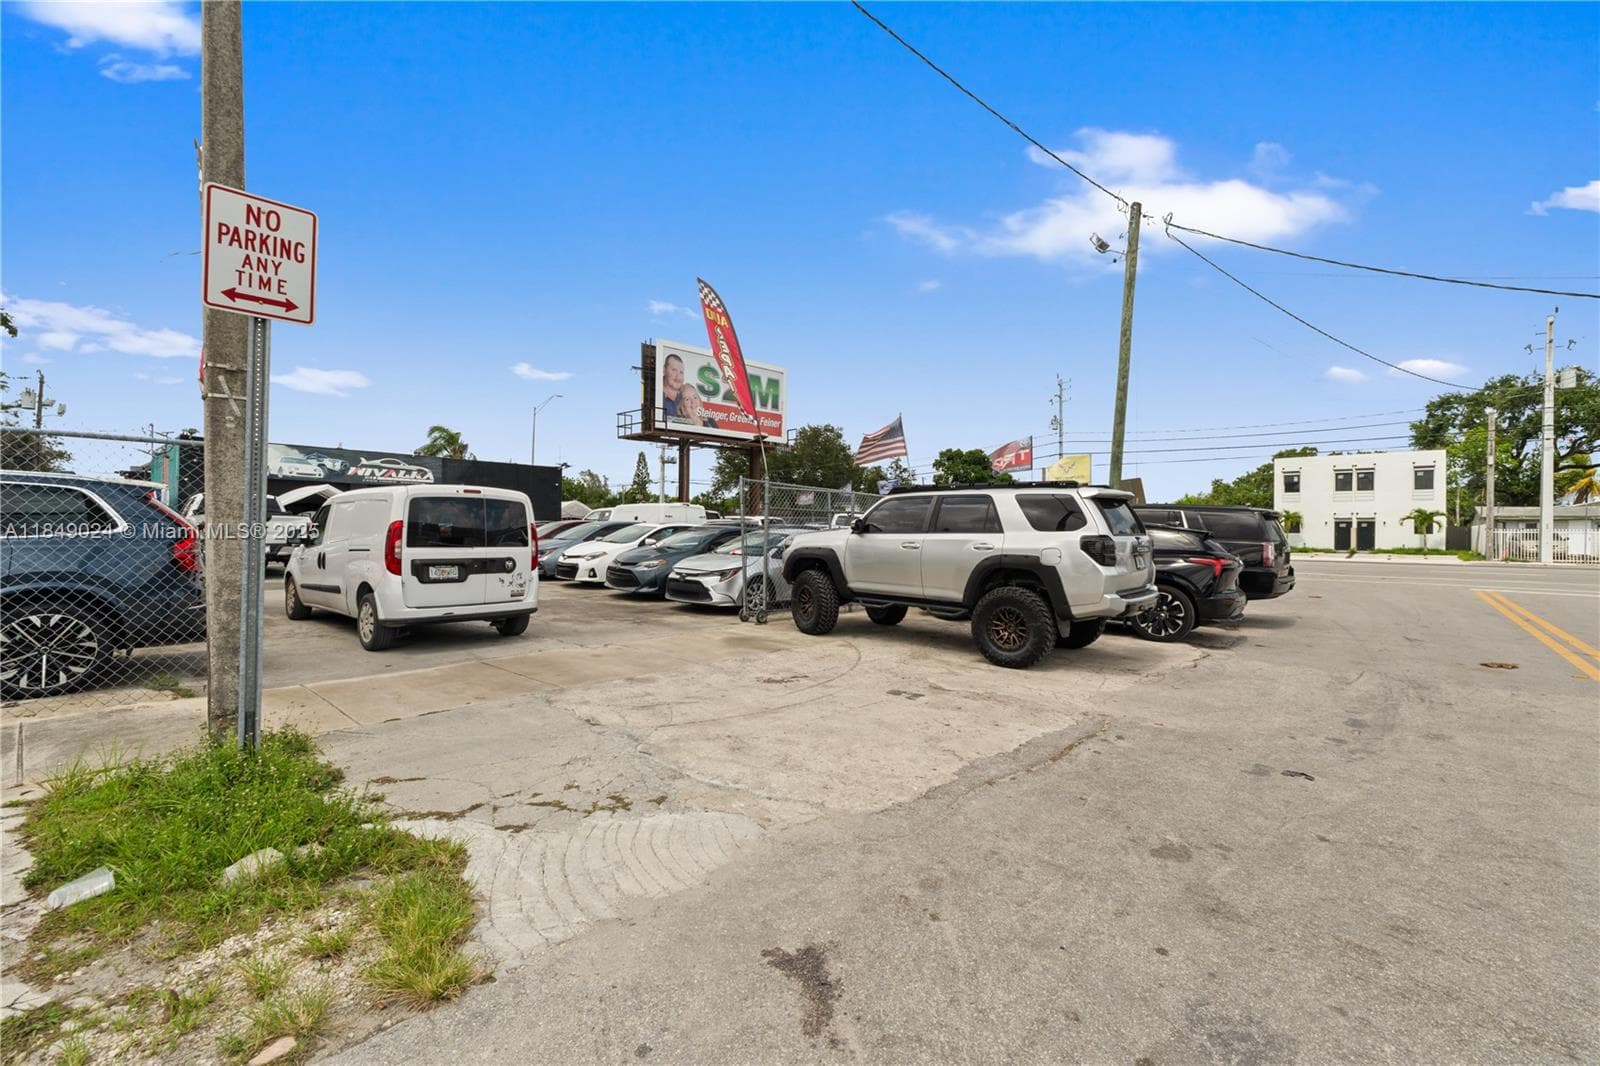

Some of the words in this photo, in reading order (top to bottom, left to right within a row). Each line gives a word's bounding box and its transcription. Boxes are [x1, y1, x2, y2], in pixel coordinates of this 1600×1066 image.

[245, 203, 281, 233] NO
[217, 222, 305, 264] PARKING
[241, 253, 282, 276] ANY
[235, 269, 287, 296] TIME
[696, 407, 729, 422] Steinger,
[760, 416, 781, 429] Feiner
